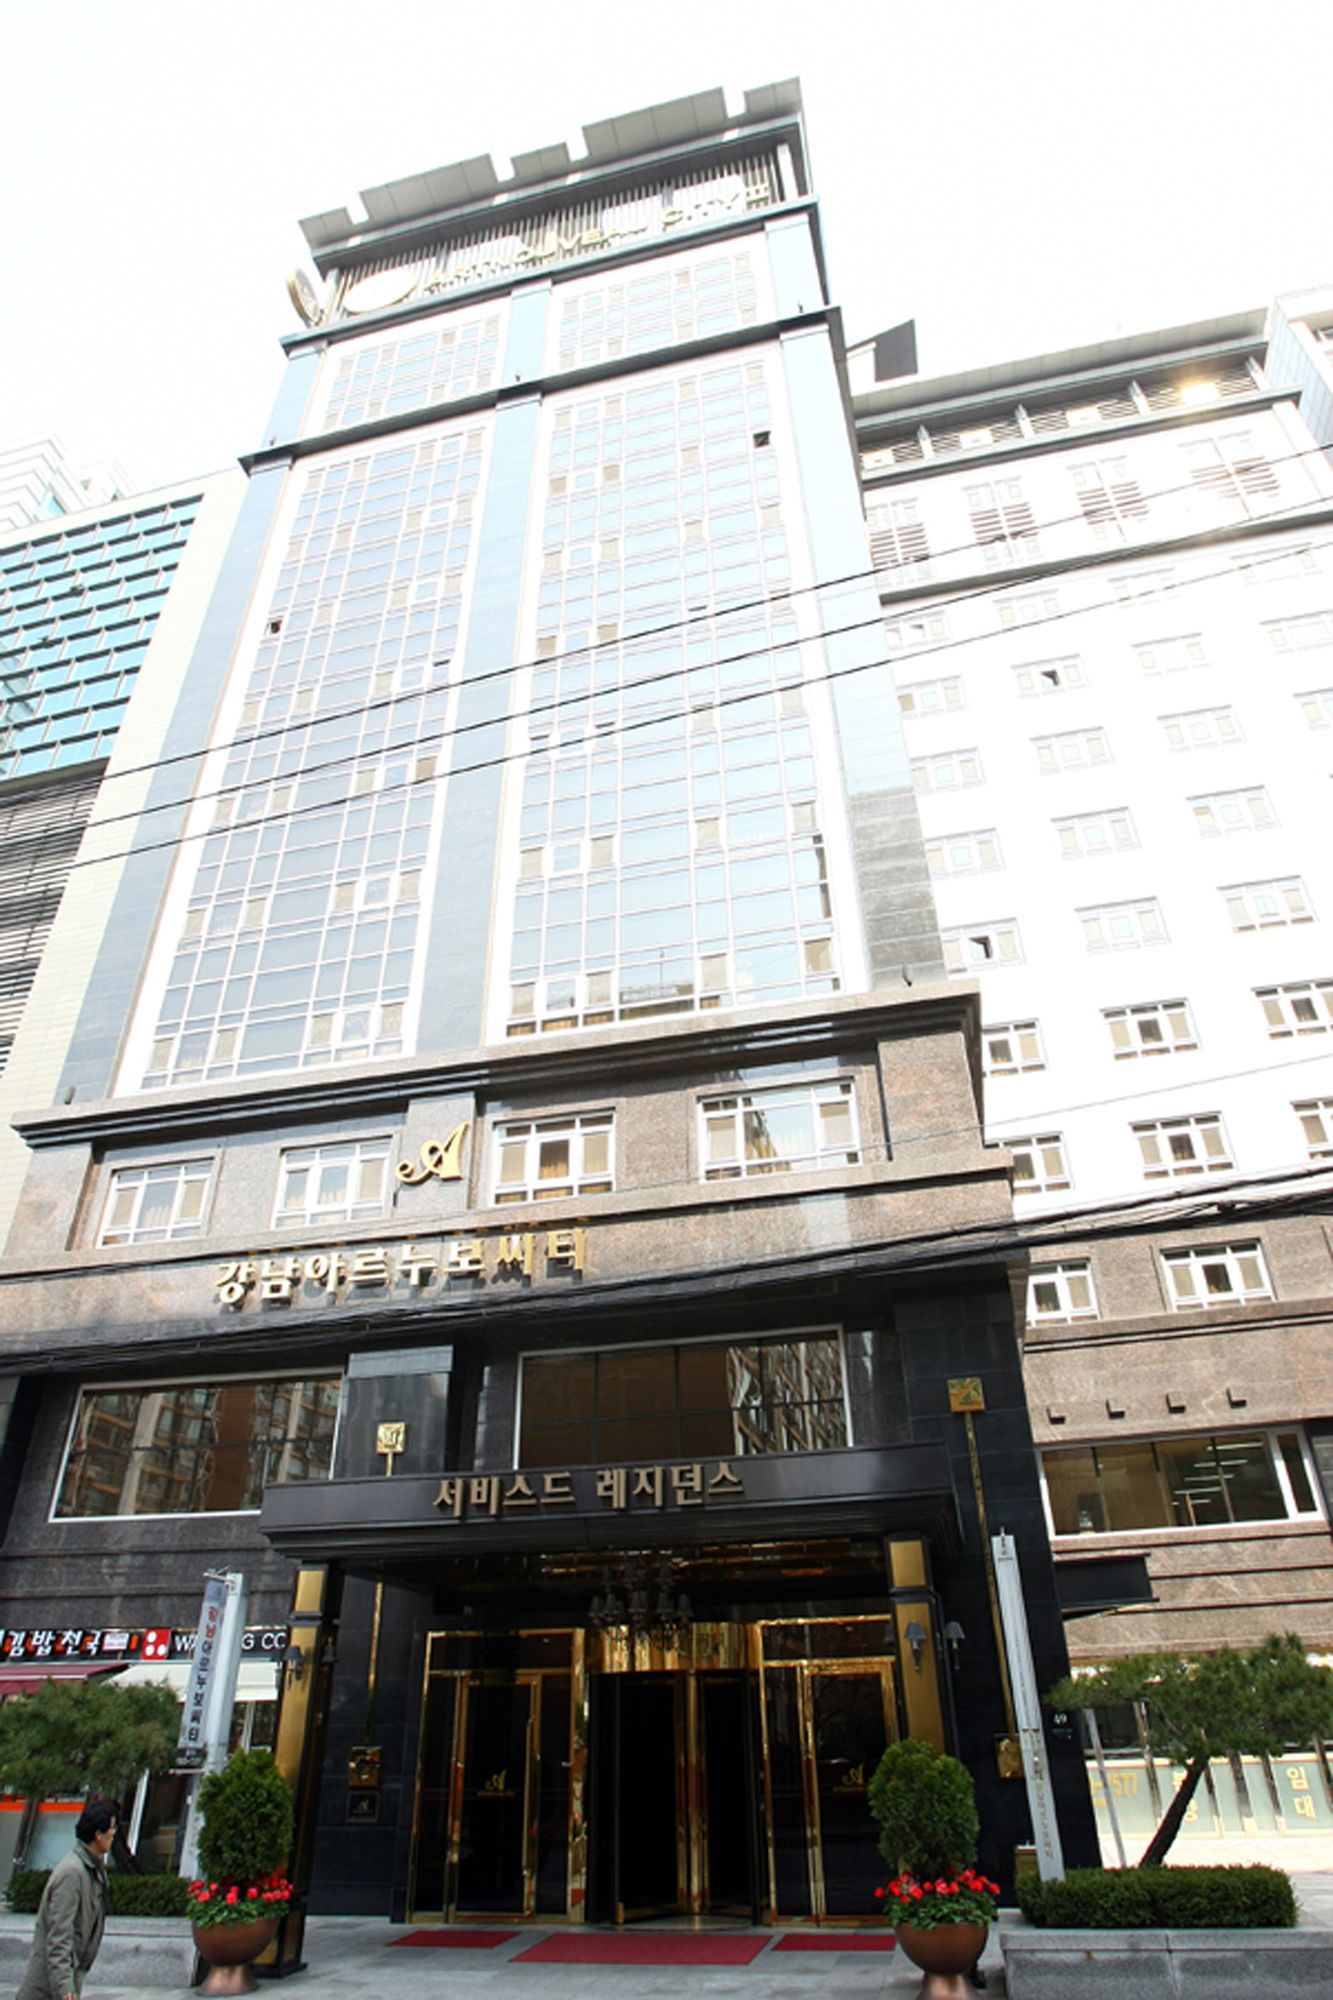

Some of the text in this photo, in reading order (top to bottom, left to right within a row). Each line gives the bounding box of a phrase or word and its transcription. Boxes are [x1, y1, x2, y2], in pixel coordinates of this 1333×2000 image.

[216, 1227, 585, 1304] 강남아르누보씨티
[433, 1461, 745, 1518] 서비스드 레지던스
